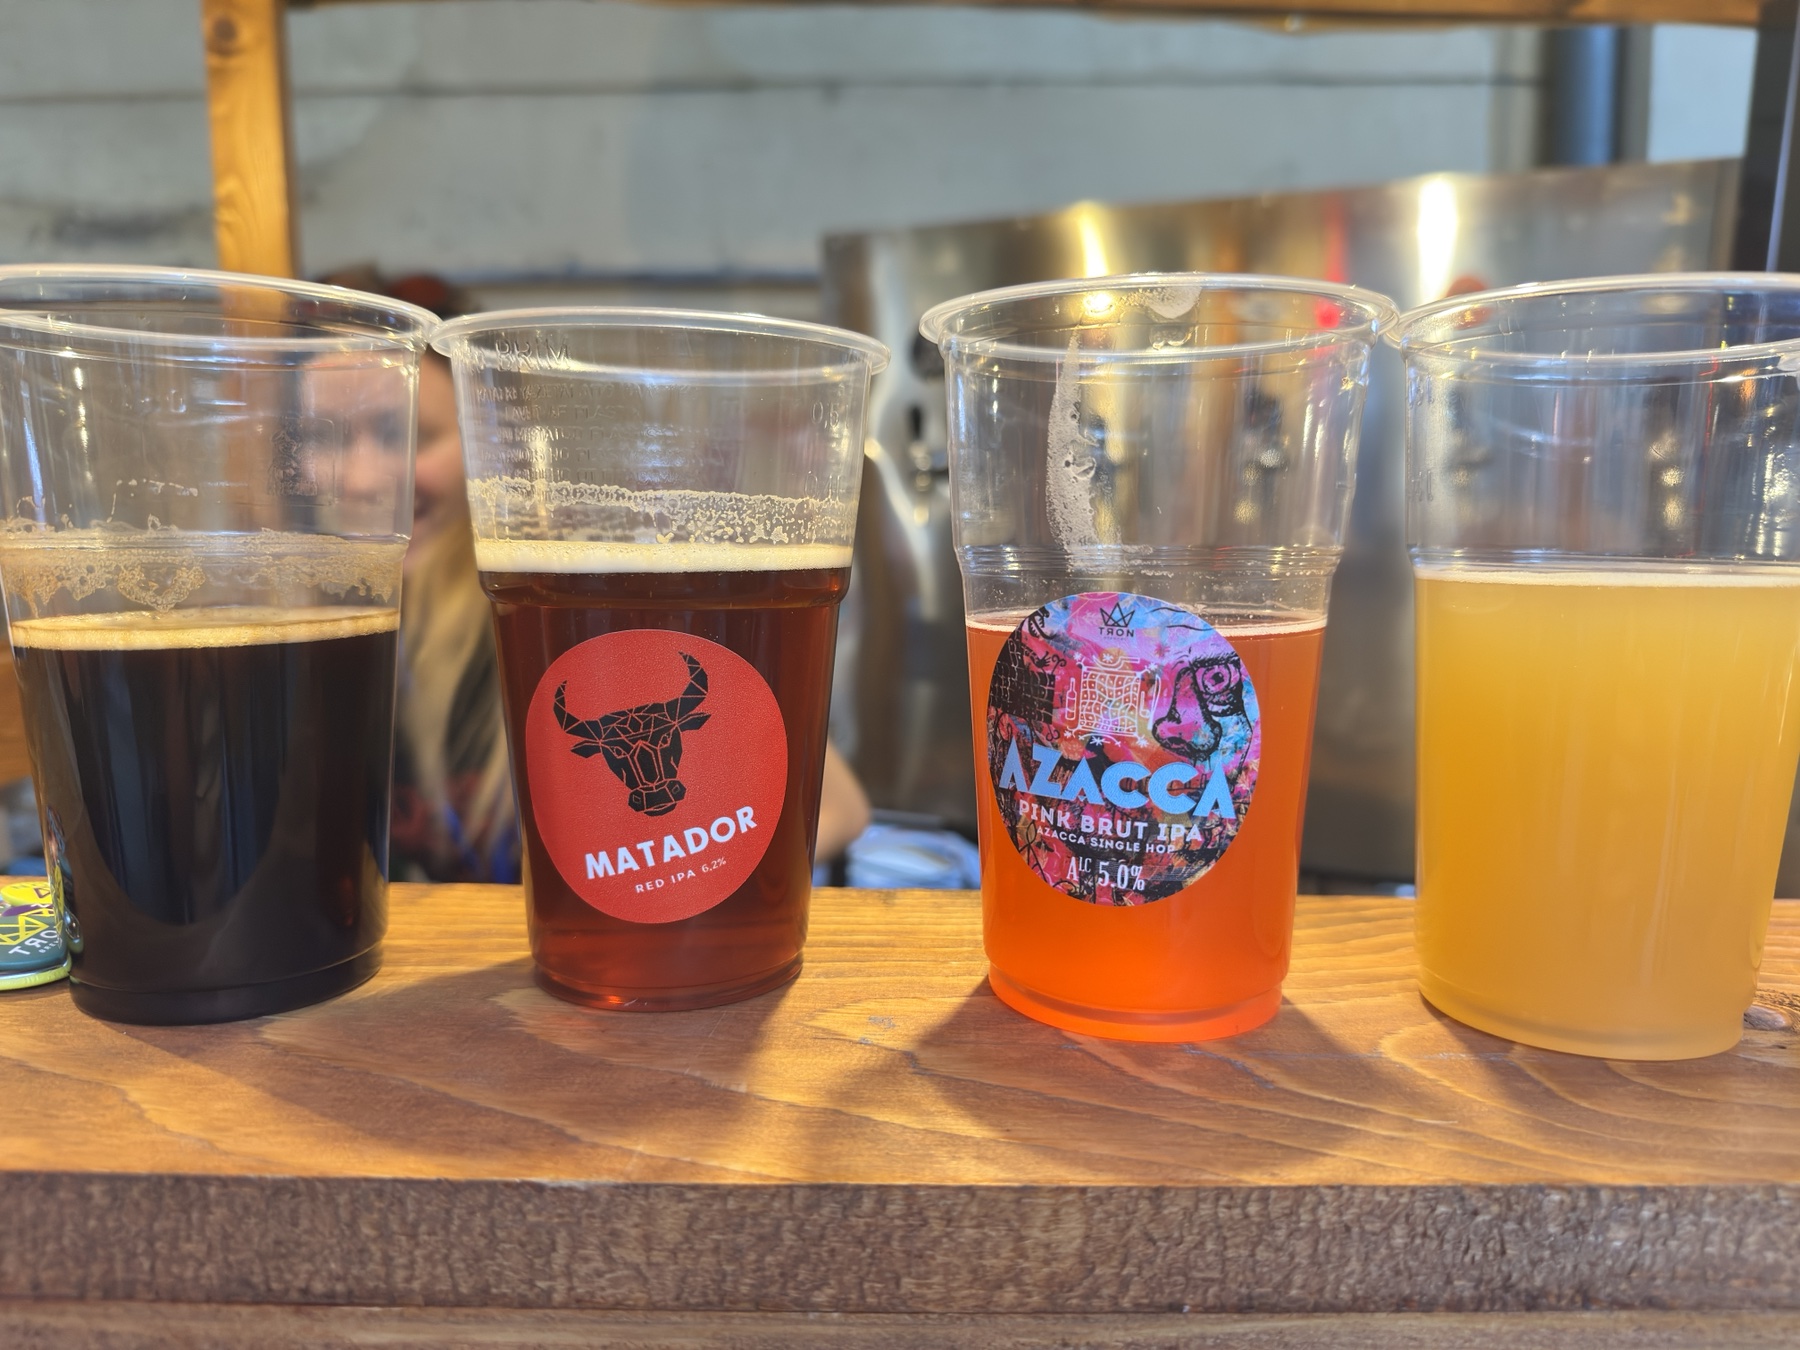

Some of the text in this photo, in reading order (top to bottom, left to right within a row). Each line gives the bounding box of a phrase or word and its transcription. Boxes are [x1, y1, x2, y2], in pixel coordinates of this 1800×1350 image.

[999, 738, 1236, 819] AZACCA
[1019, 799, 1203, 842] PINK BRUT IPA
[584, 806, 758, 880] MATADOR
[1036, 825, 1175, 854] AZACCA SINGLE HOP
[635, 857, 727, 894] RED IPA 6.2%
[1098, 861, 1146, 891] 5.0%
[8, 929, 58, 956] TRO
